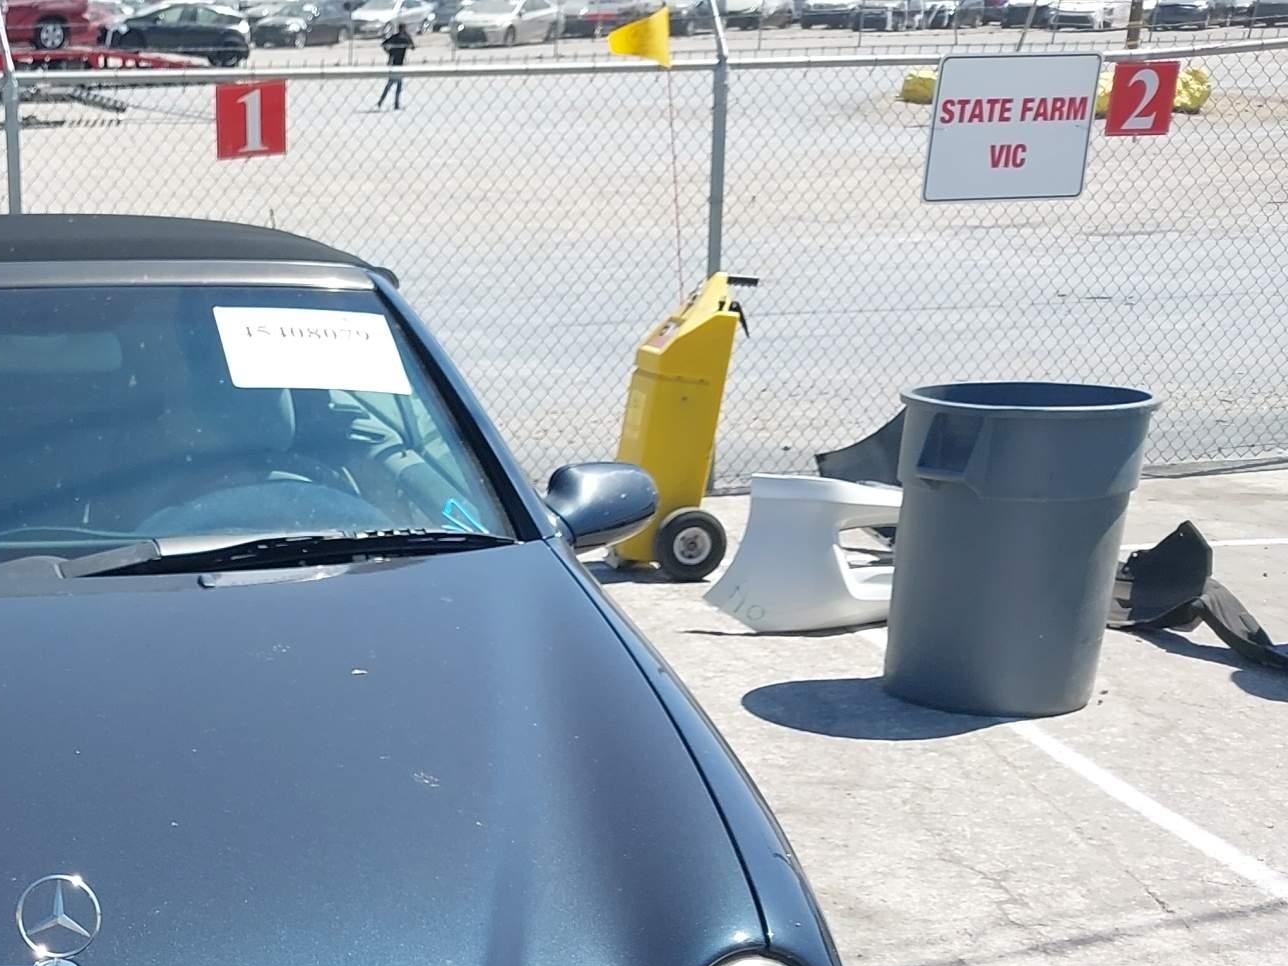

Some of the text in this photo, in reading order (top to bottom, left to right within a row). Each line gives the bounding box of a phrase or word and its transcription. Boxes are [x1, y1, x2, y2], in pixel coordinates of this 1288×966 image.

[235, 87, 270, 153] 1
[939, 96, 1089, 124] STATE FARM
[1120, 68, 1161, 130] 2
[989, 143, 1028, 169] VIC
